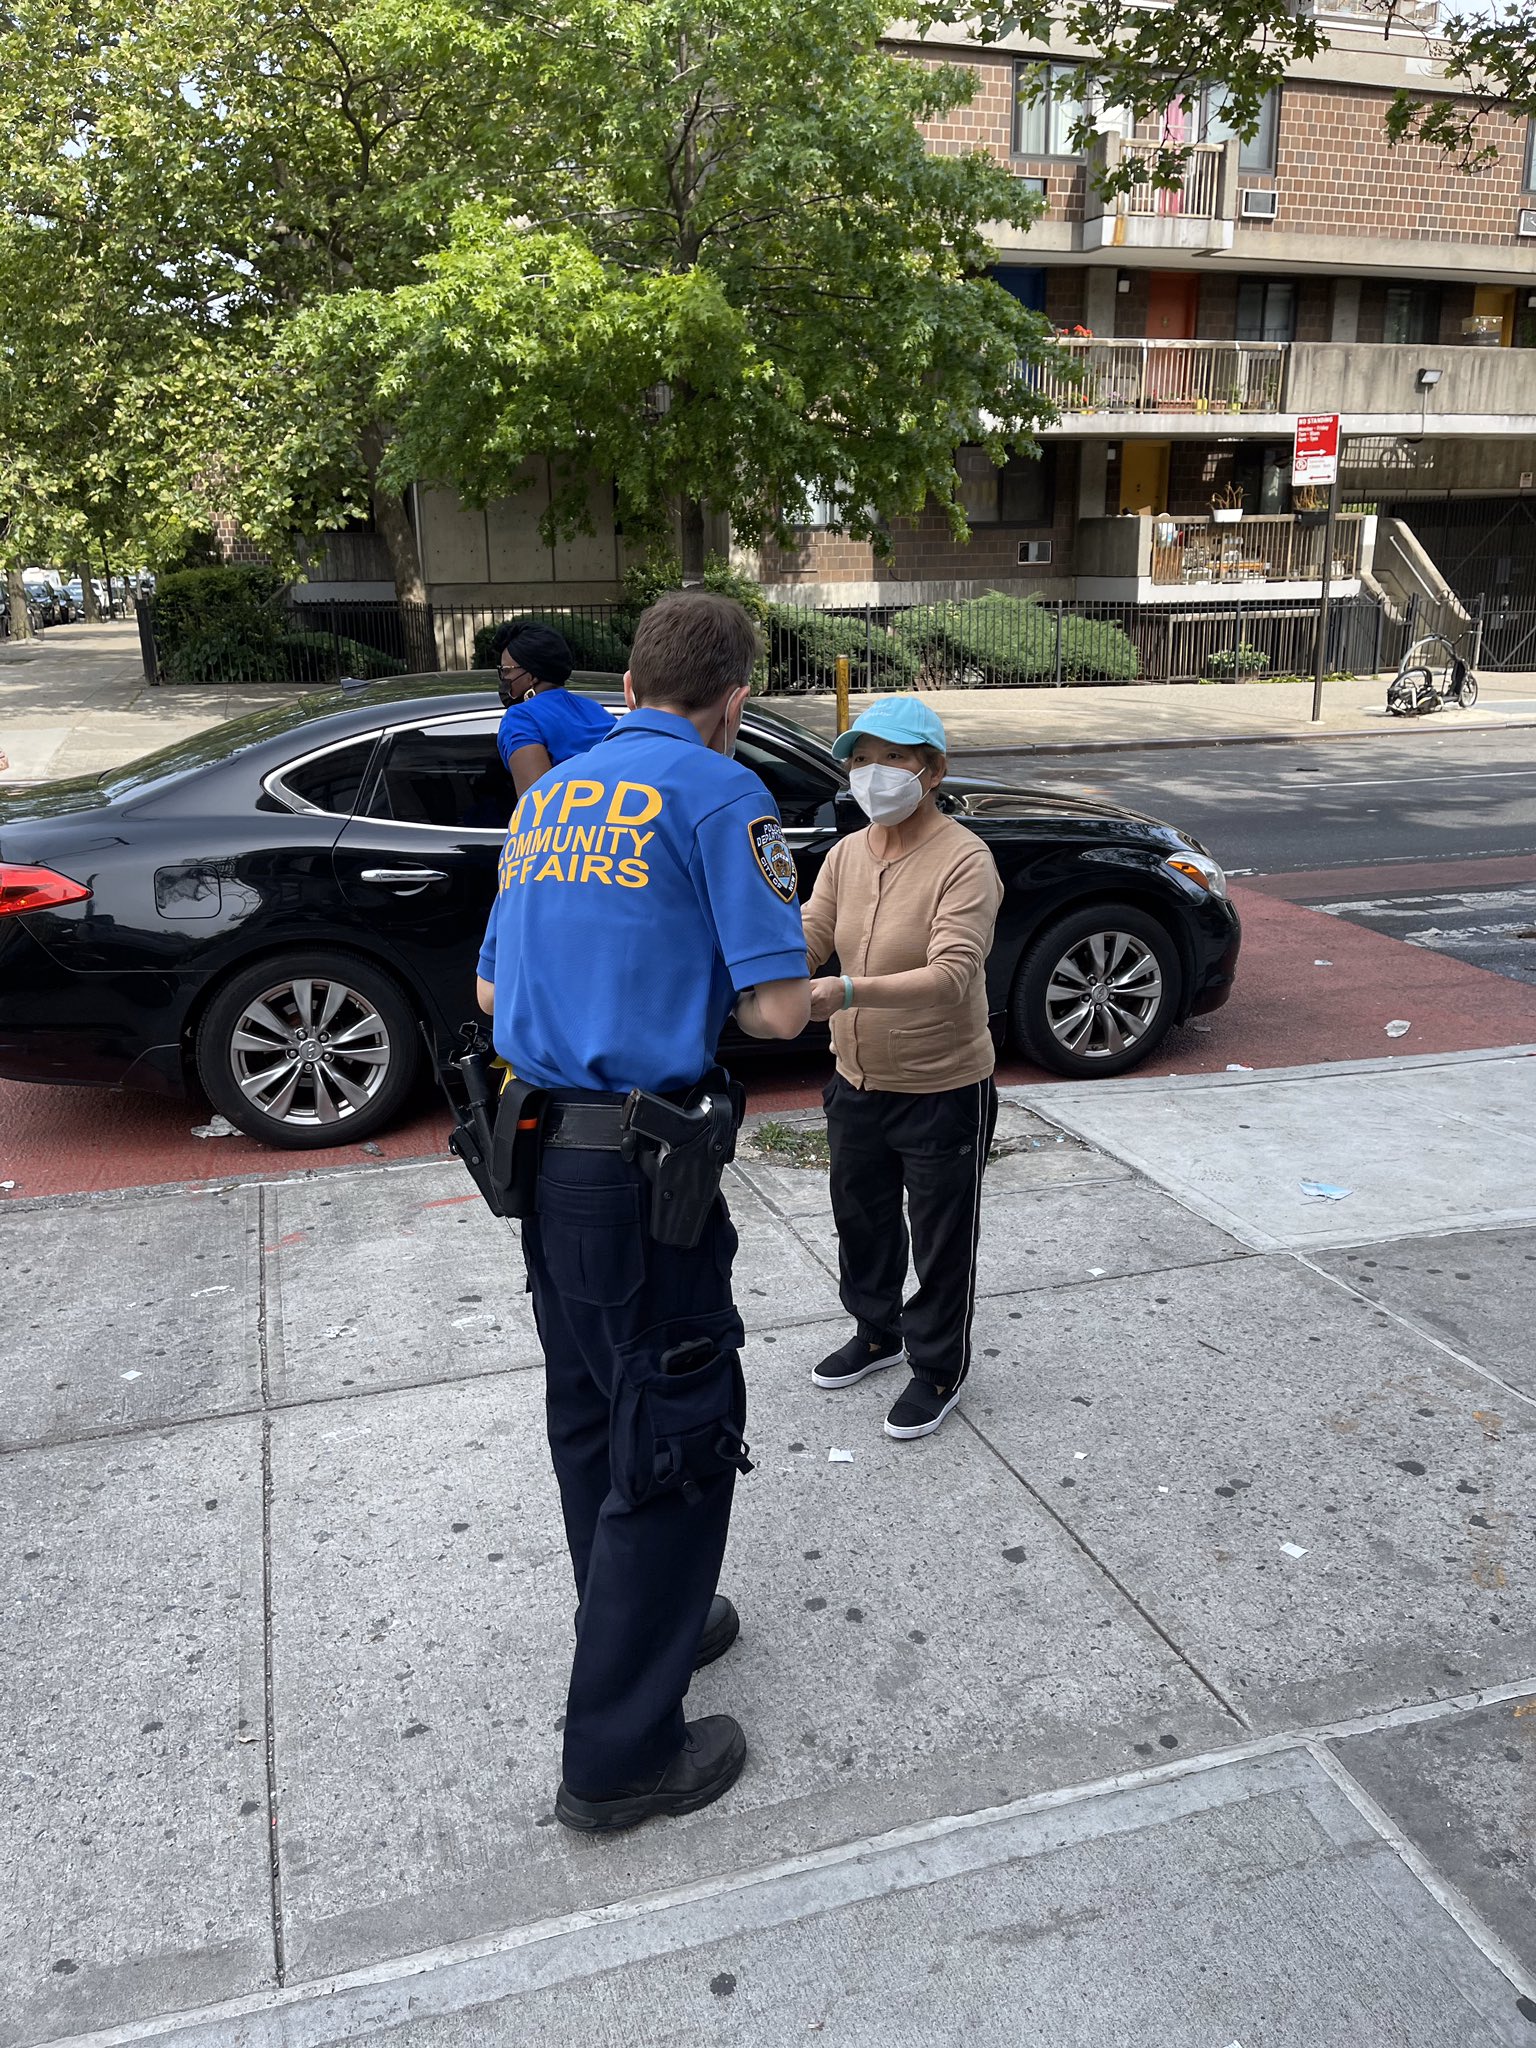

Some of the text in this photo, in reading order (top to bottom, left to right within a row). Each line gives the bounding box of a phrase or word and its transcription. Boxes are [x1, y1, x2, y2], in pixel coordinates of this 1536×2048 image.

[1307, 416, 1333, 424] STANDING
[763, 823, 781, 834] POLIC
[498, 826, 655, 870] OMMUNITY
[760, 856, 774, 877] CITY
